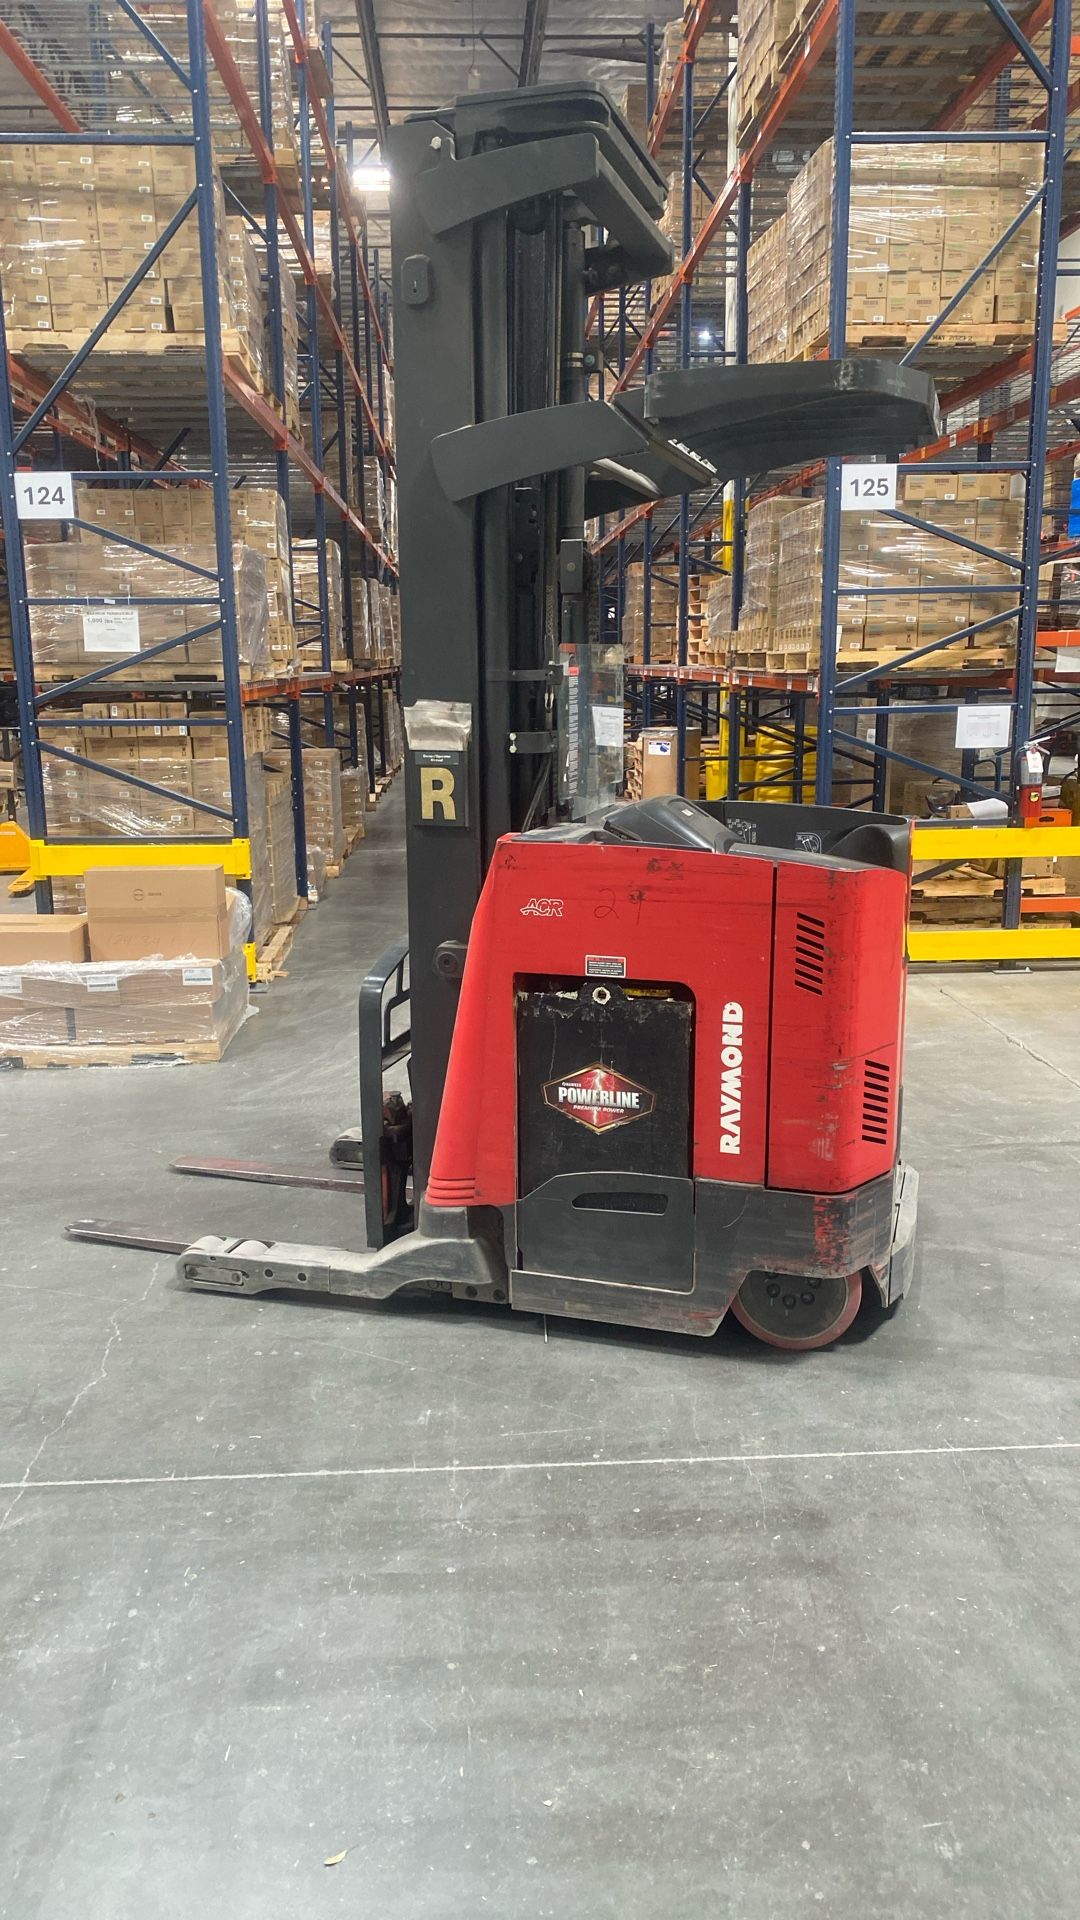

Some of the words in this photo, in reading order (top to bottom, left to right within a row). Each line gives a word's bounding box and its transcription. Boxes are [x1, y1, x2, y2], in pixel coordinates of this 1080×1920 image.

[24, 486, 66, 505] 124
[850, 478, 889, 497] 125
[420, 767, 456, 820] R
[520, 898, 564, 917] ACR
[719, 1001, 744, 1155] RAYMOND
[558, 1086, 640, 1109] POWERLINE
[573, 1104, 602, 1113] PREMIUM
